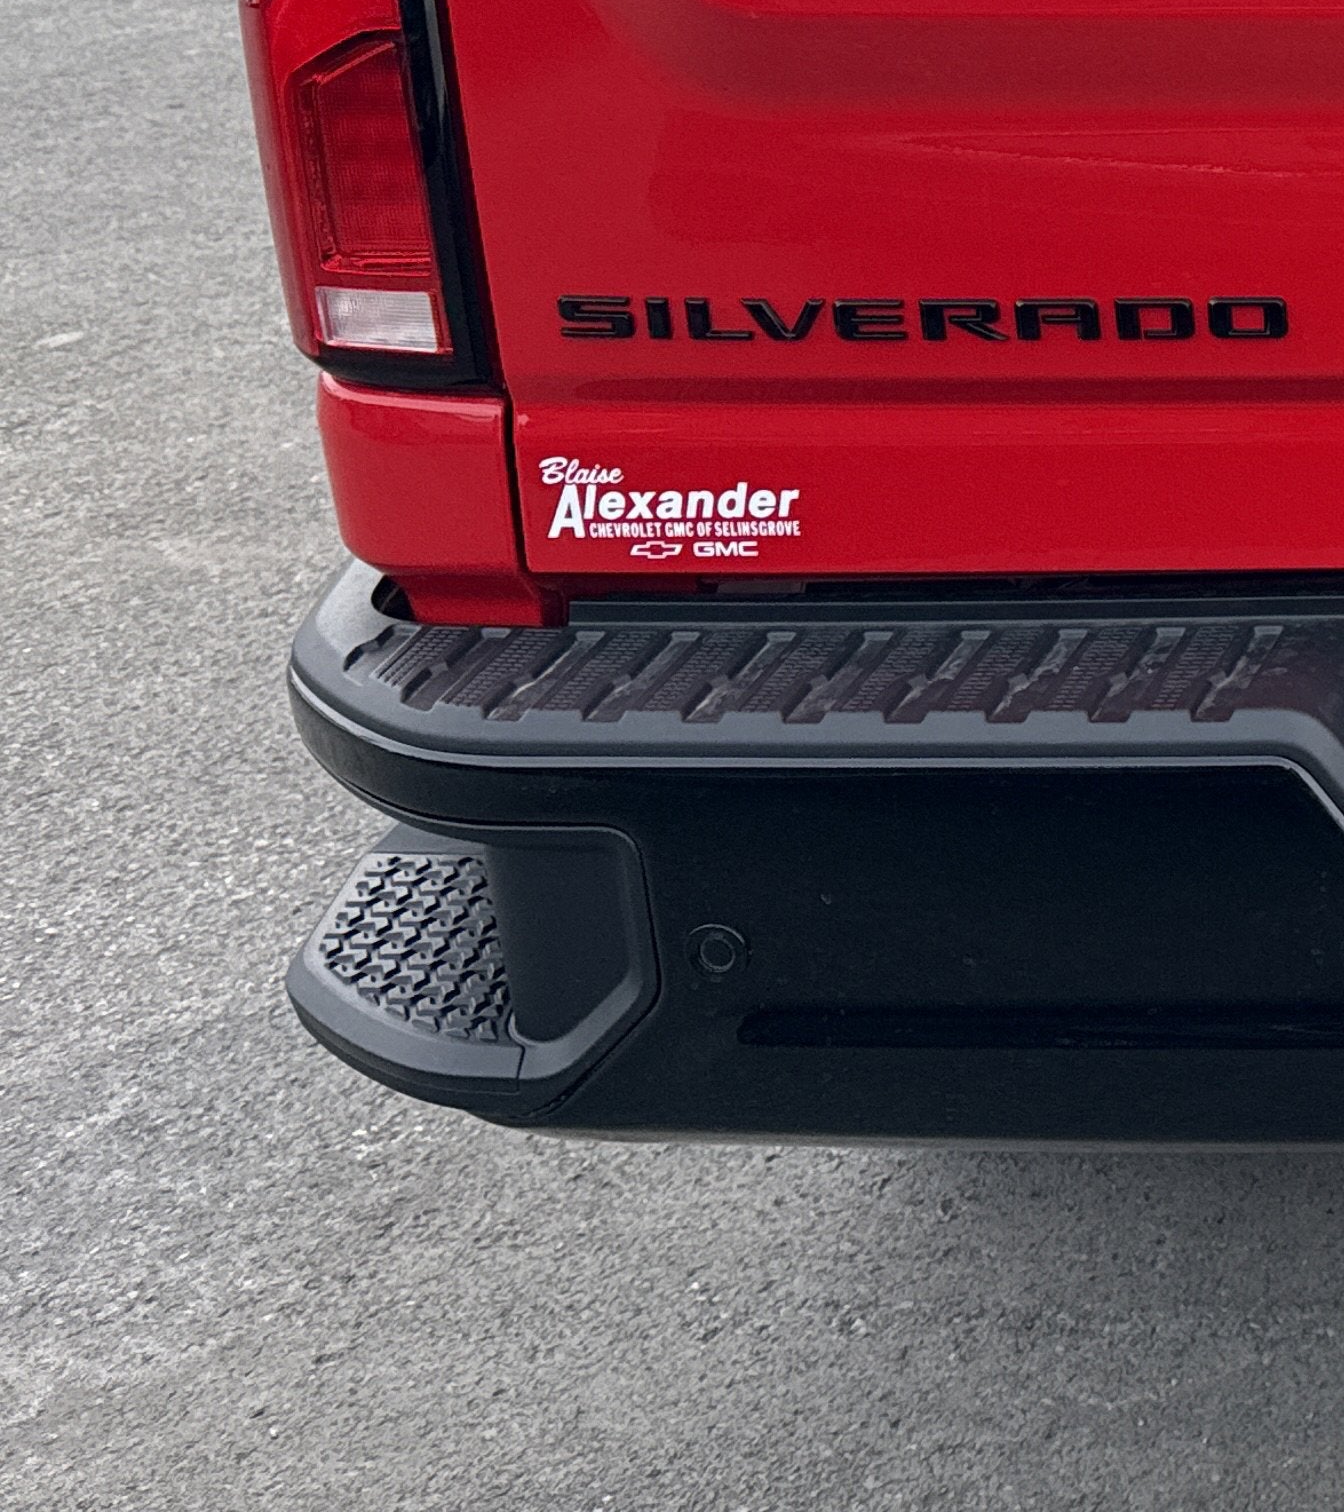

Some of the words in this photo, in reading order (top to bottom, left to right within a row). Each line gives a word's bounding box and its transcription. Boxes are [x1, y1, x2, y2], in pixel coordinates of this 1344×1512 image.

[557, 294, 1289, 341] SILVERADO
[539, 456, 625, 485] Blaise
[548, 482, 800, 538] Alexander
[589, 522, 662, 538] CHEVROLET
[665, 522, 694, 538] GMC
[697, 522, 713, 537] OF
[714, 520, 801, 537] SELINSGROVE
[693, 541, 759, 557] GMC
